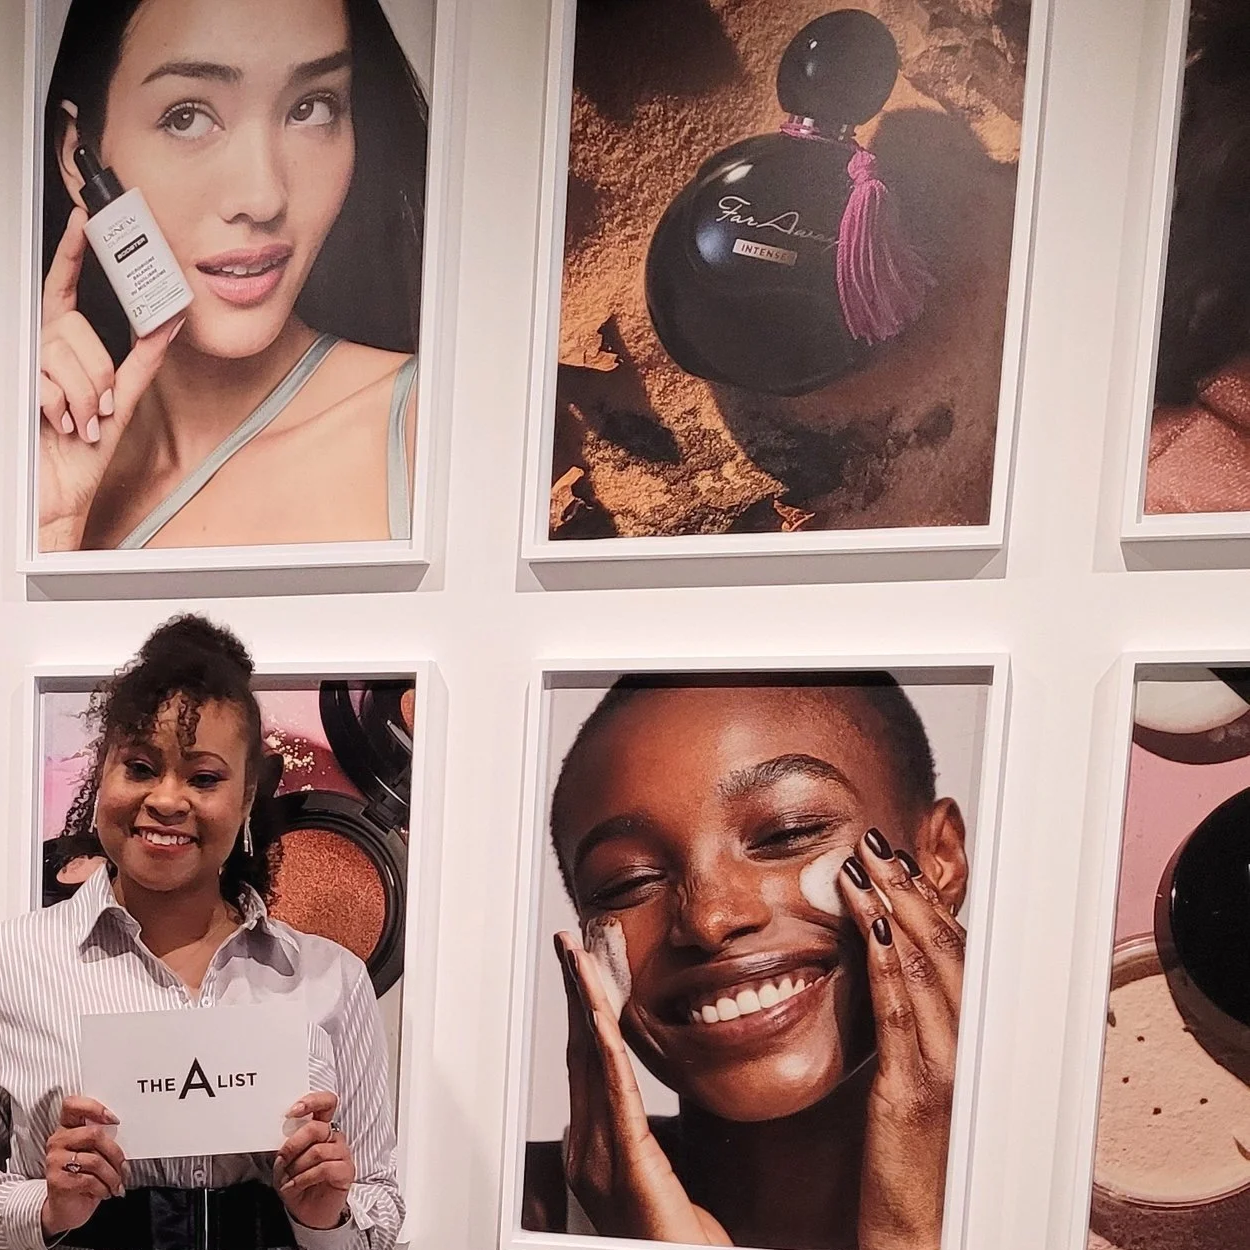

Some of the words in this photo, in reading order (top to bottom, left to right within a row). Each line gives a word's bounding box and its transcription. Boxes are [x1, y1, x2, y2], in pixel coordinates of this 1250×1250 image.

[716, 196, 758, 227] Far
[741, 243, 790, 260] INTENSE
[137, 1078, 176, 1093] THE
[178, 1057, 216, 1099] A
[217, 1072, 257, 1088] LIST
